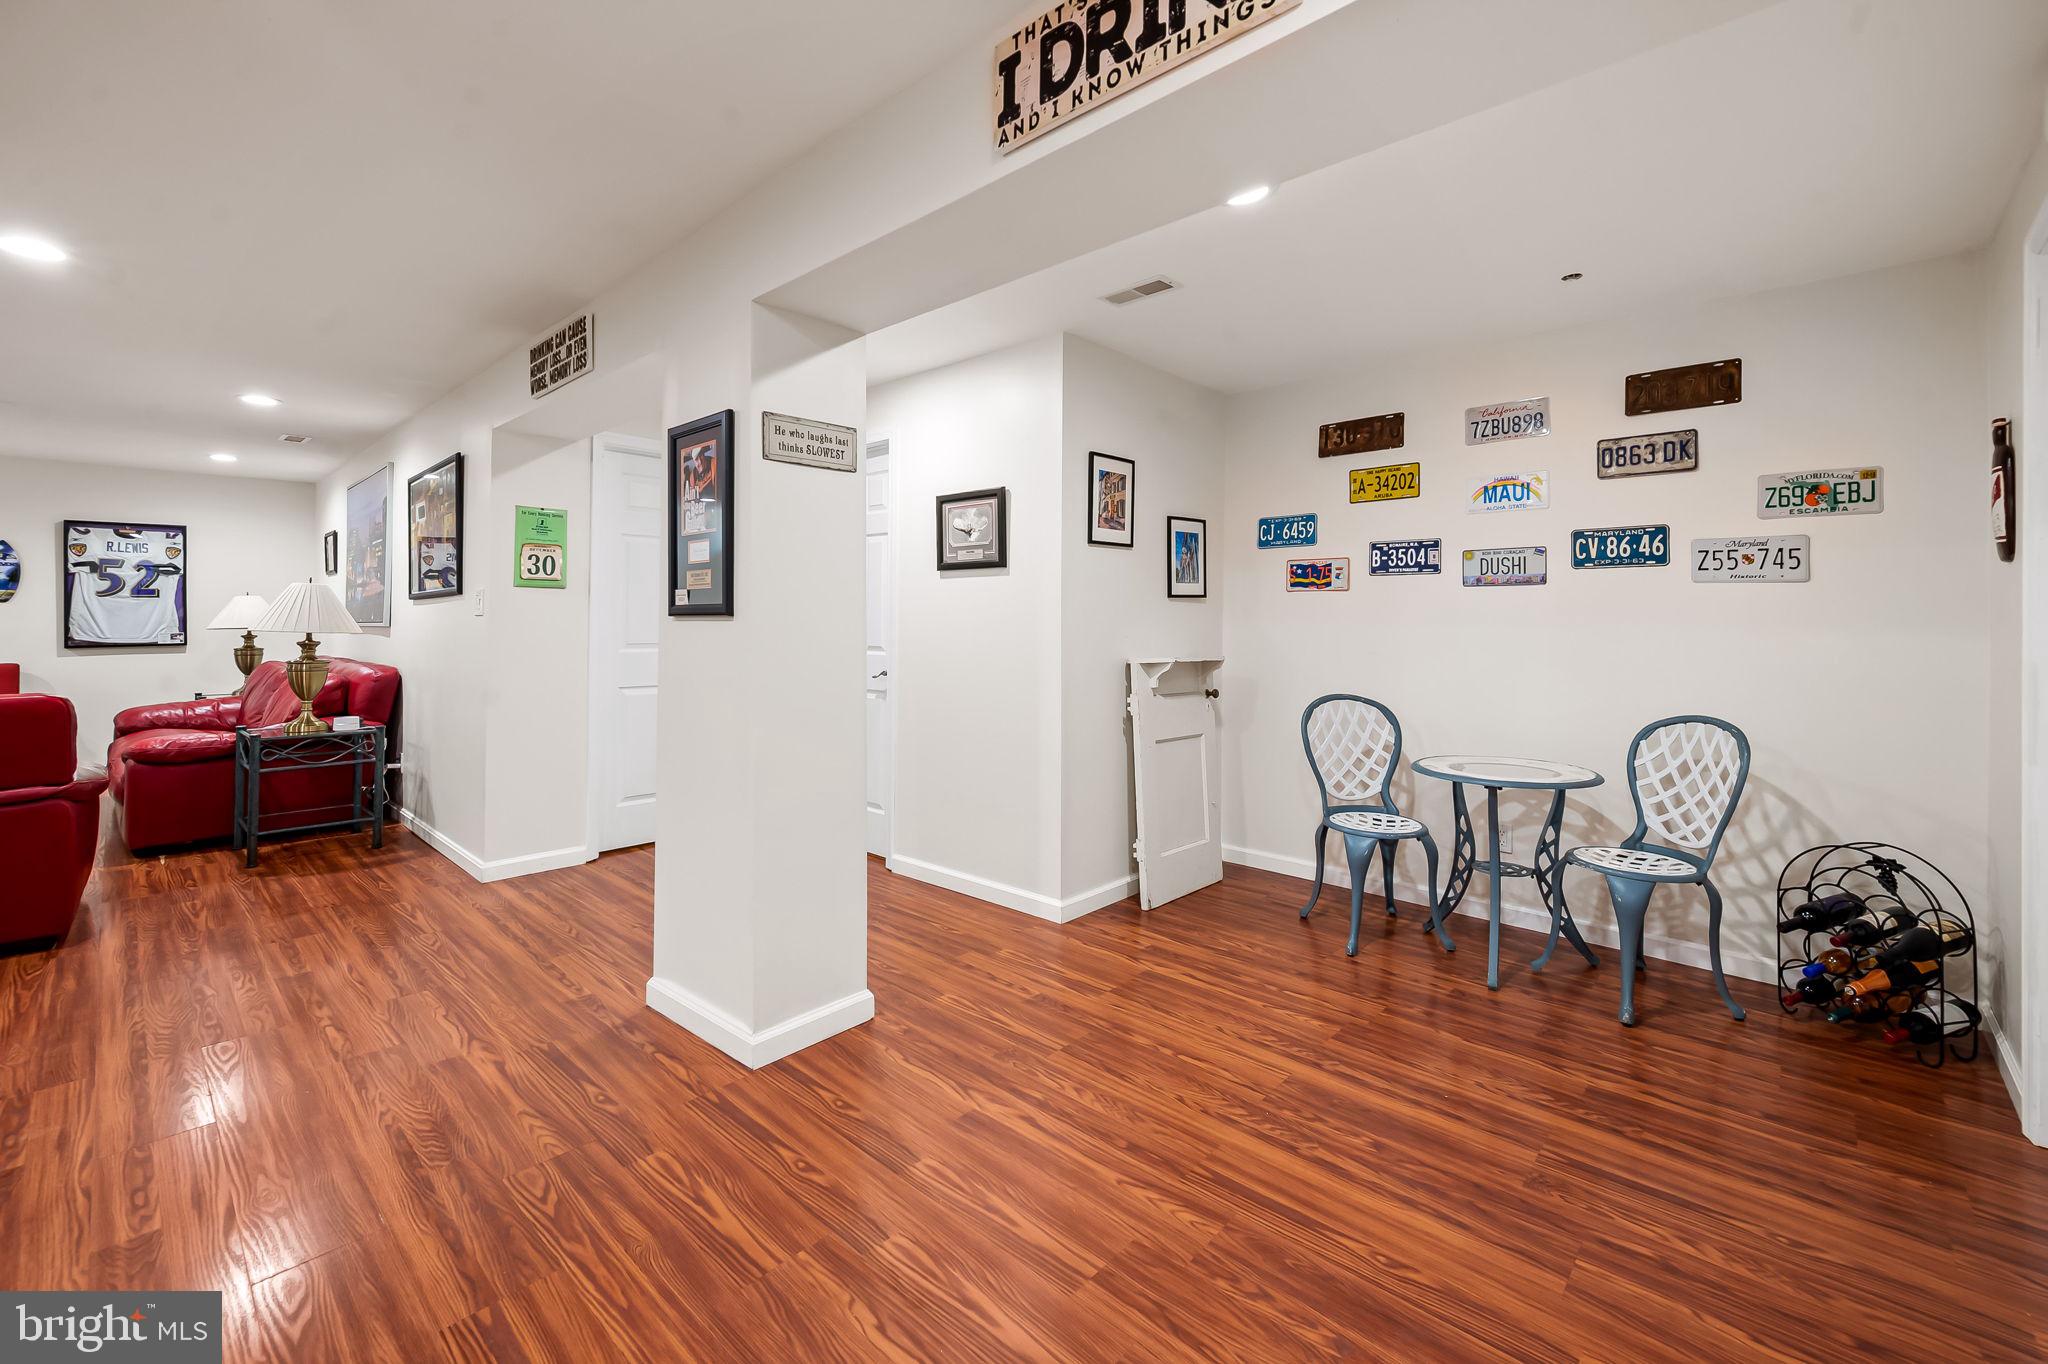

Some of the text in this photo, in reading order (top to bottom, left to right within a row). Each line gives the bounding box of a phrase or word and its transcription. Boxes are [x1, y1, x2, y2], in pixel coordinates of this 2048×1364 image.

[998, 50, 1021, 128] I
[998, 112, 1040, 147] AND
[1052, 99, 1060, 118] I
[1072, 53, 1146, 111] KNOW
[554, 328, 567, 350] CAN
[568, 315, 587, 342] CAUSE
[574, 333, 587, 355] EVEN
[550, 357, 571, 386] MEMORY
[573, 350, 588, 374] LOSS
[1481, 405, 1534, 418] California
[774, 424, 849, 447] He who laughs last
[1470, 411, 1544, 439] 7ZBU898
[778, 440, 846, 460] thinks SLOWEST
[1357, 472, 1416, 495] A-34202
[1483, 482, 1531, 504] MAUI
[1764, 479, 1876, 509] Z69 EBJ
[1594, 528, 1644, 537] MARYLAND
[1725, 538, 1770, 550] Maryland
[526, 553, 556, 576] 30
[1372, 547, 1426, 568] B-3504
[1480, 555, 1527, 576] DUSHI
[1697, 547, 1801, 571] Z55 745
[95, 558, 160, 598] 52
